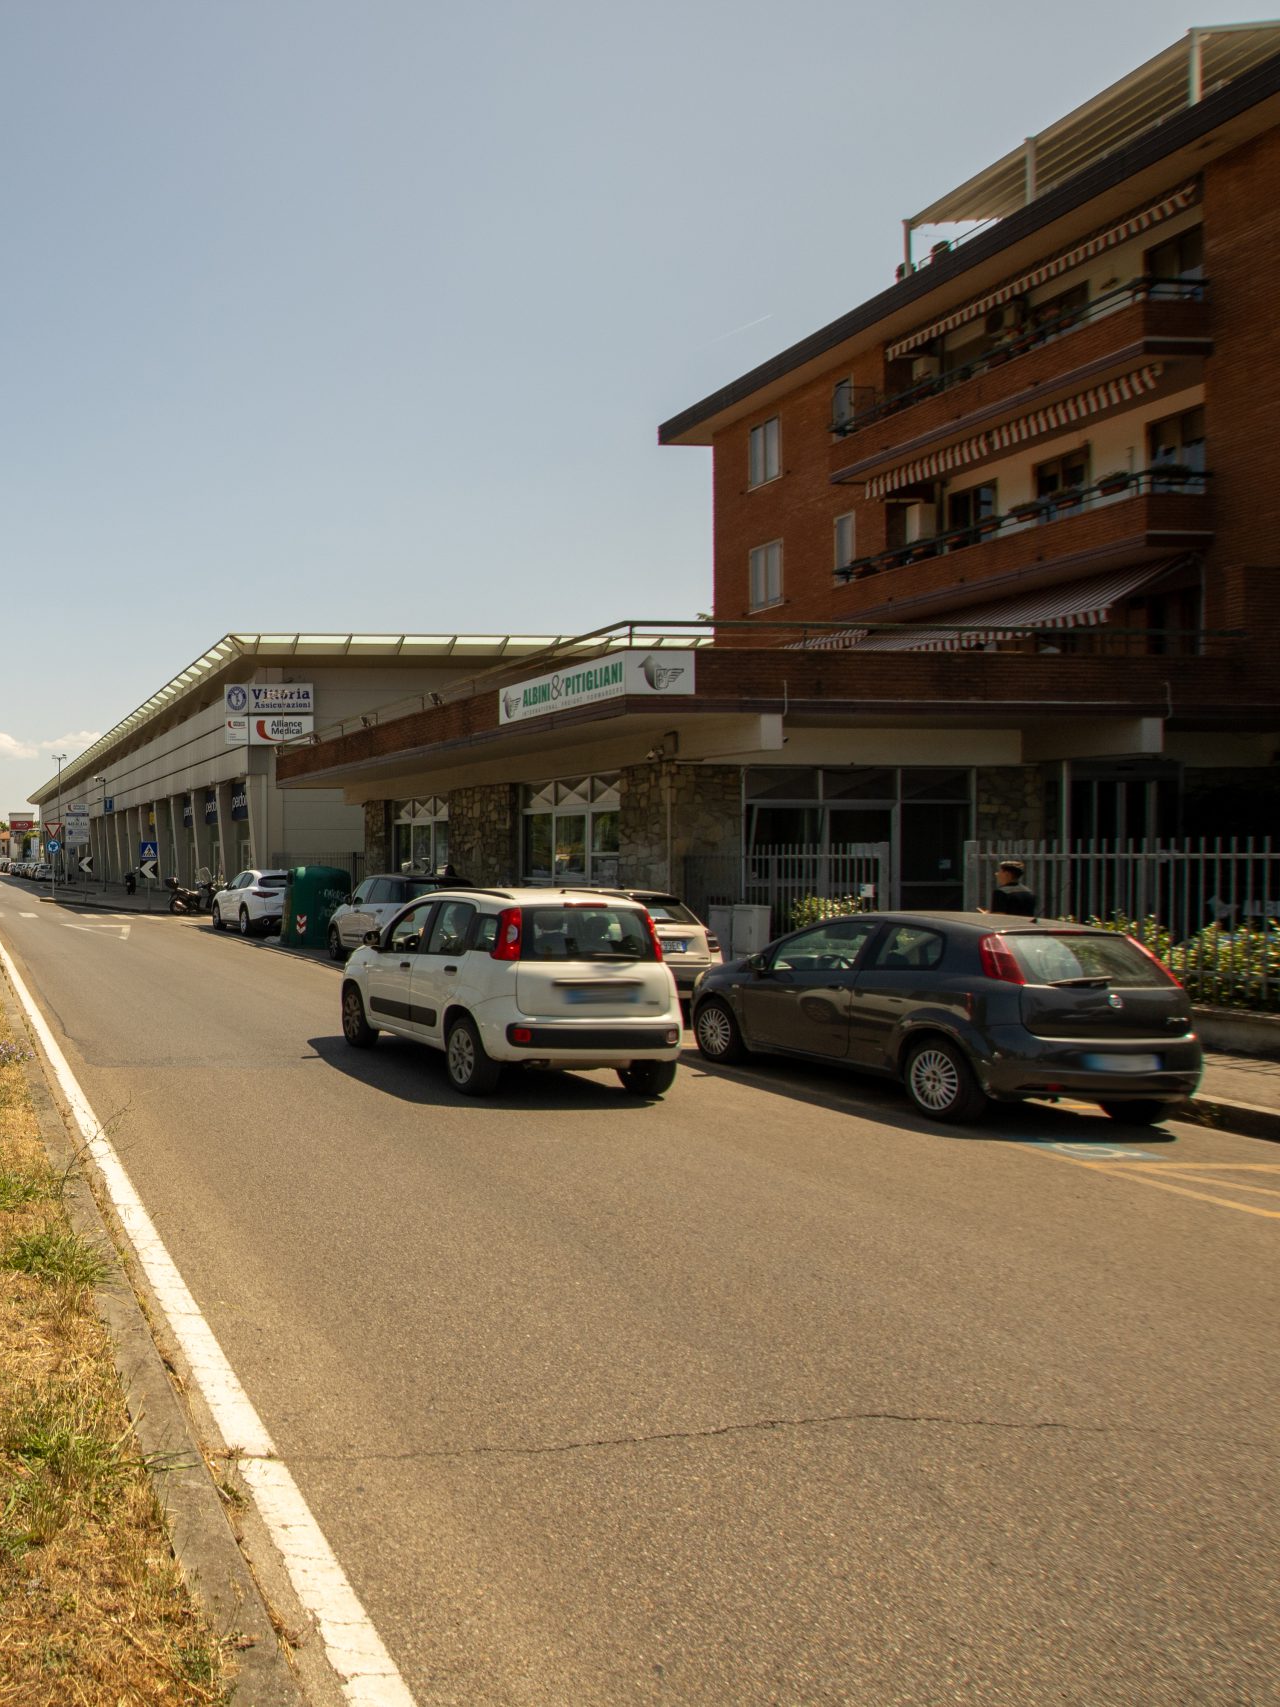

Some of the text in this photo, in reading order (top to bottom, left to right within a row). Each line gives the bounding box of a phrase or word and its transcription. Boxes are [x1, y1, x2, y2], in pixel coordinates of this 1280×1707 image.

[523, 661, 623, 708] ALBINI & PITIGLIANI
[252, 688, 310, 700] Vittoria
[254, 701, 311, 709] Assicurazioni
[271, 720, 302, 728] Alliance
[271, 727, 303, 735] Medical
